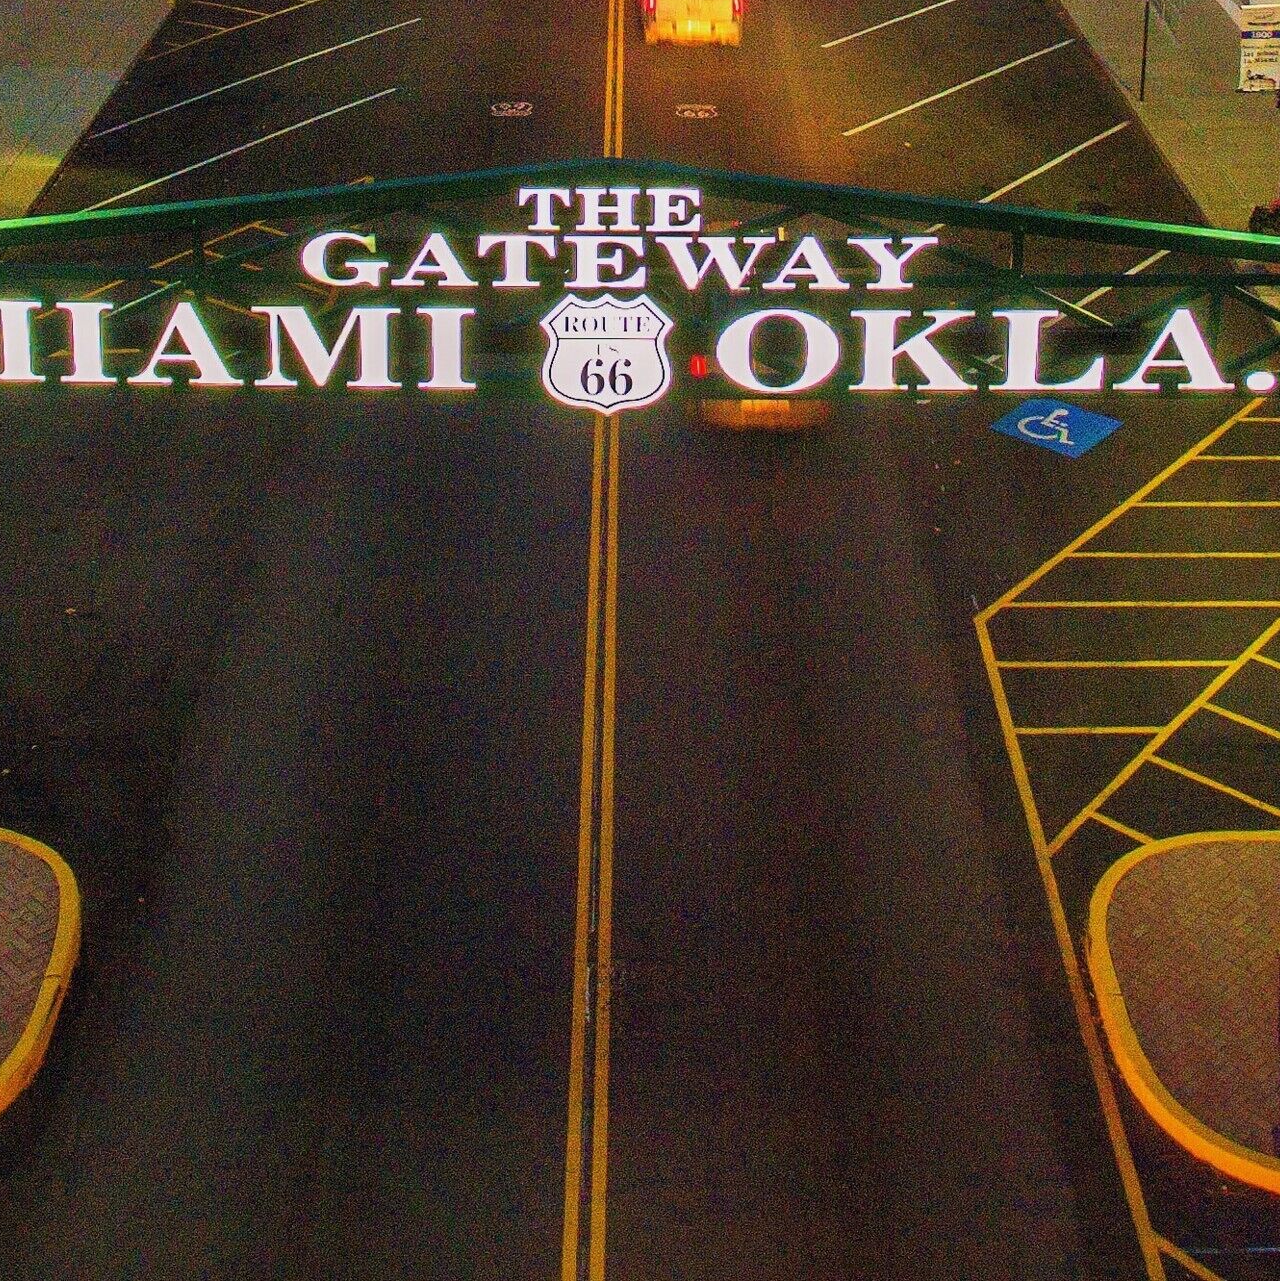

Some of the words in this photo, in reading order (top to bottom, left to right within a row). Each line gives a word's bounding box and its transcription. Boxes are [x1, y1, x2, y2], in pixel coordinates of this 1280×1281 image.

[518, 186, 702, 232] THE
[301, 231, 940, 290] GATEWAY
[564, 316, 650, 333] ROUTE
[715, 307, 1276, 394] OKLA.
[580, 358, 633, 395] 66
